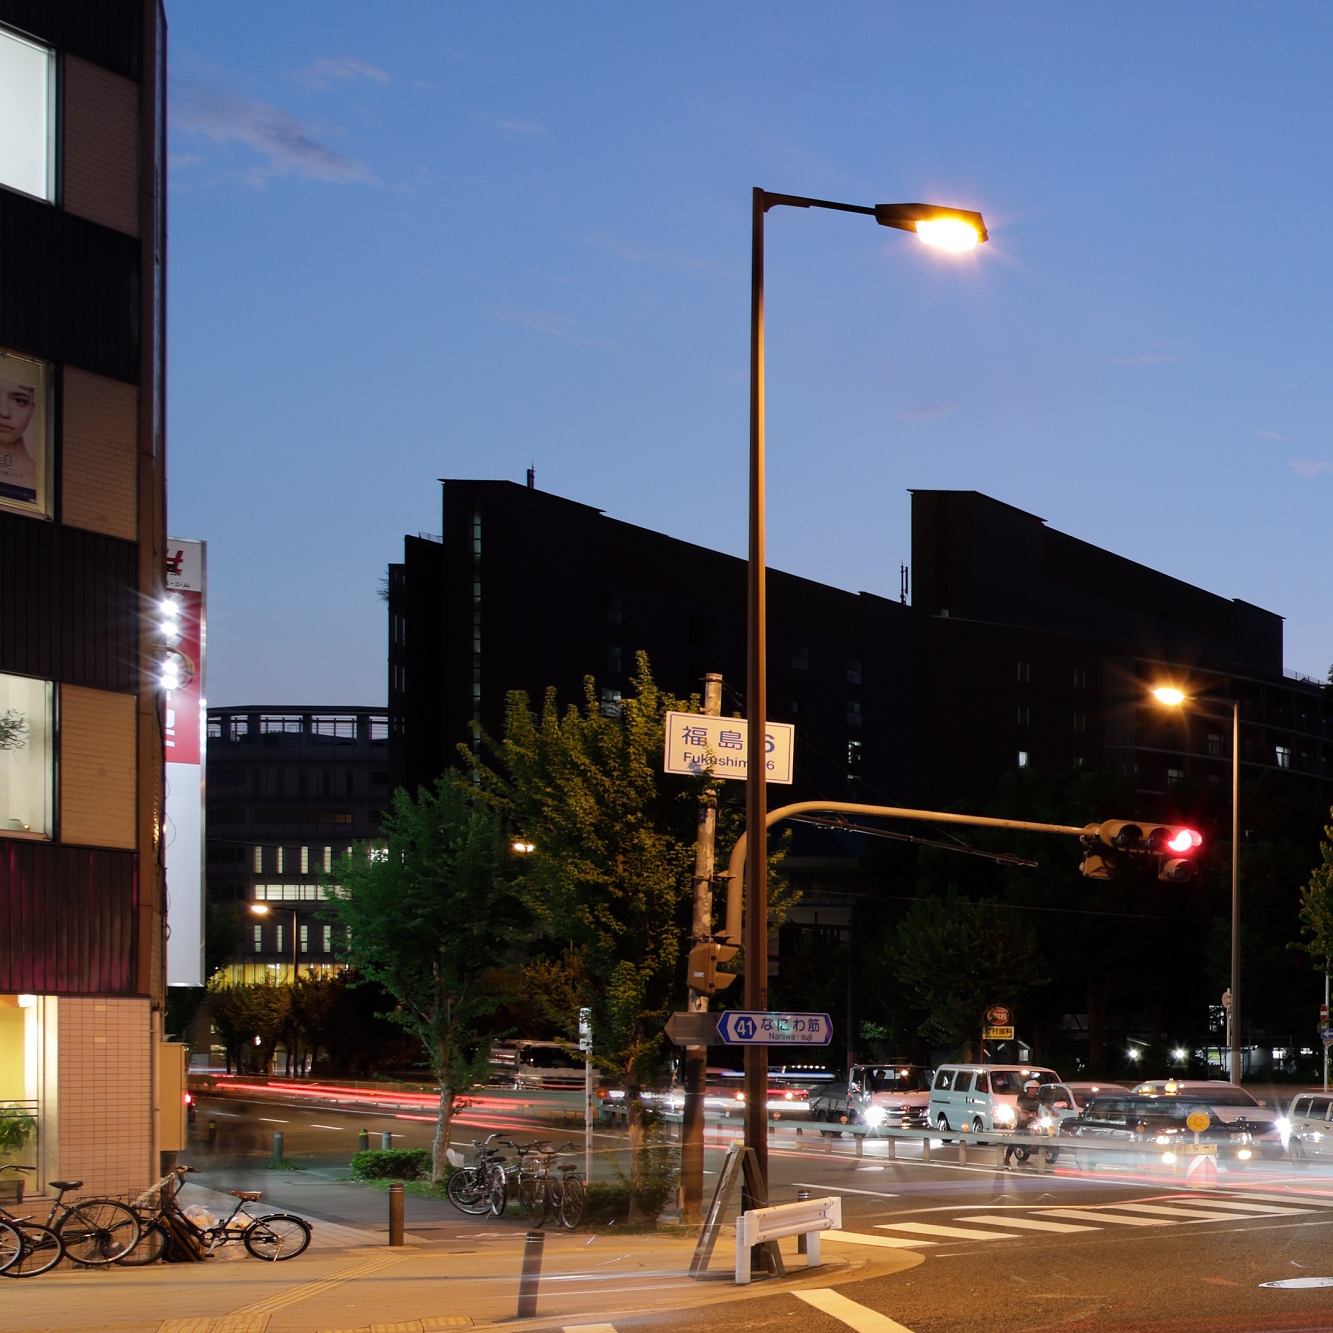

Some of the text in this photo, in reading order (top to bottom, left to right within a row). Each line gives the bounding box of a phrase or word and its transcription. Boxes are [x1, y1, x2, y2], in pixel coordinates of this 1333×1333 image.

[683, 752, 775, 771] Fukushim 6
[736, 1020, 753, 1036] 41
[760, 1017, 820, 1033] なにわ筋
